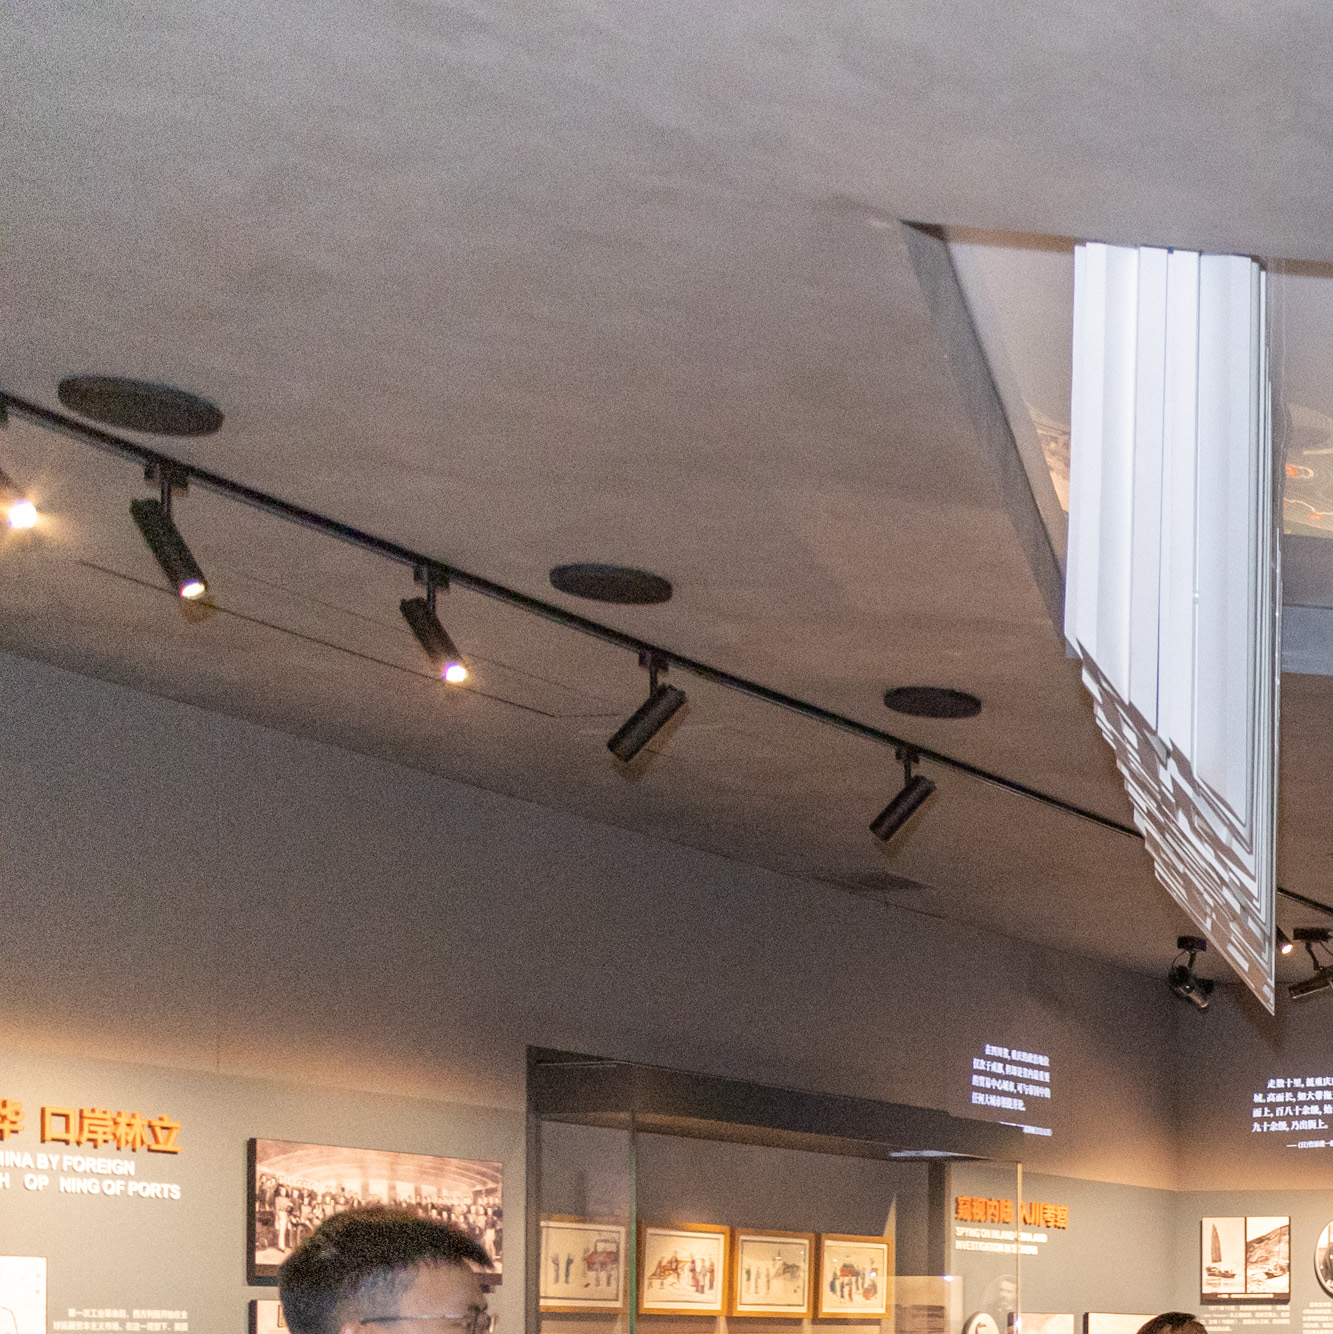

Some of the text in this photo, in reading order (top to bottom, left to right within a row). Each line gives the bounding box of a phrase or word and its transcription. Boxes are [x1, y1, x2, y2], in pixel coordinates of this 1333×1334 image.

[41, 1106, 183, 1154] 口岸林立
[0, 1151, 135, 1176] INA BY FOREIGN
[102, 1179, 126, 1196] OF
[128, 1182, 181, 1200] PORTS
